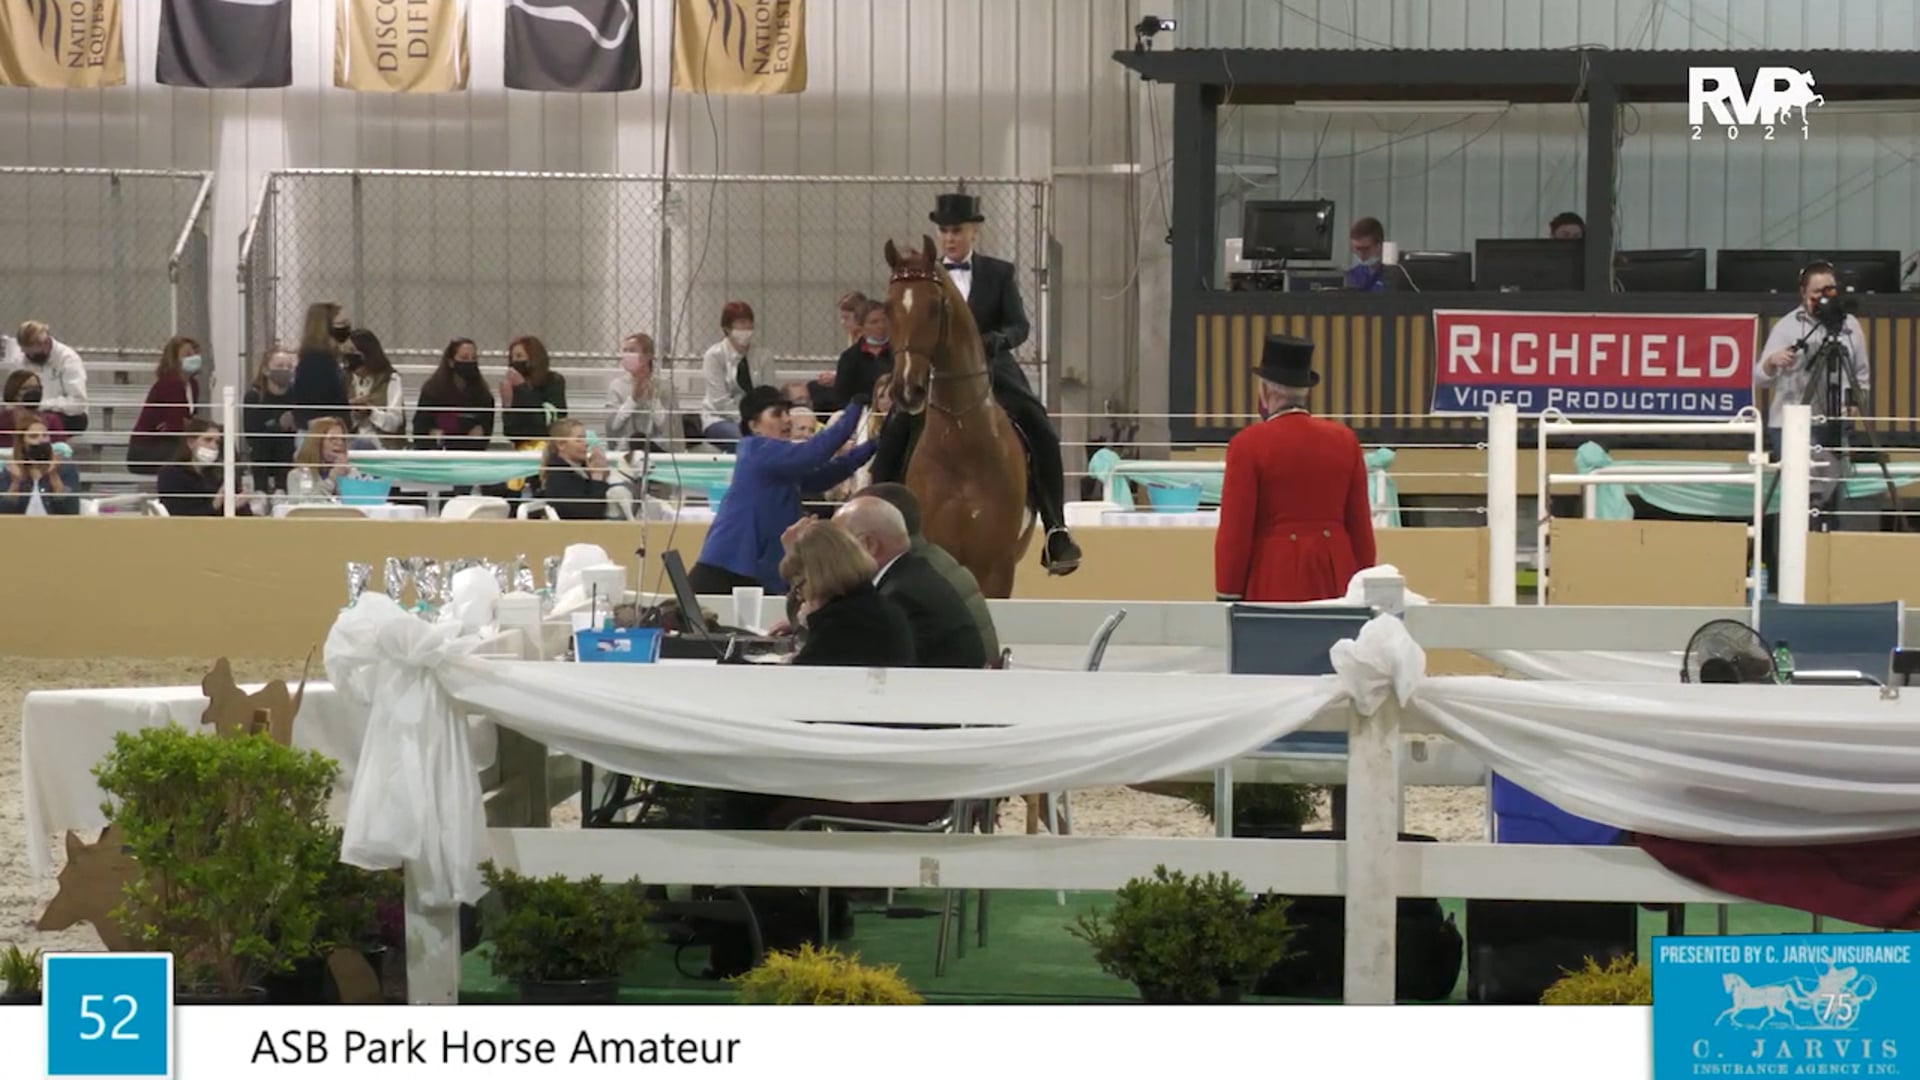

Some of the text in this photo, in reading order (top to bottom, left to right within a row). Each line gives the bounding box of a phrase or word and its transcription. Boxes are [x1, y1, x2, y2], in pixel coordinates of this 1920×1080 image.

[376, 0, 398, 71] DISC
[407, 0, 429, 58] DIF
[1449, 325, 1740, 377] RICHFIELD
[1453, 386, 1735, 411] VIDEO PRODUCTIONS
